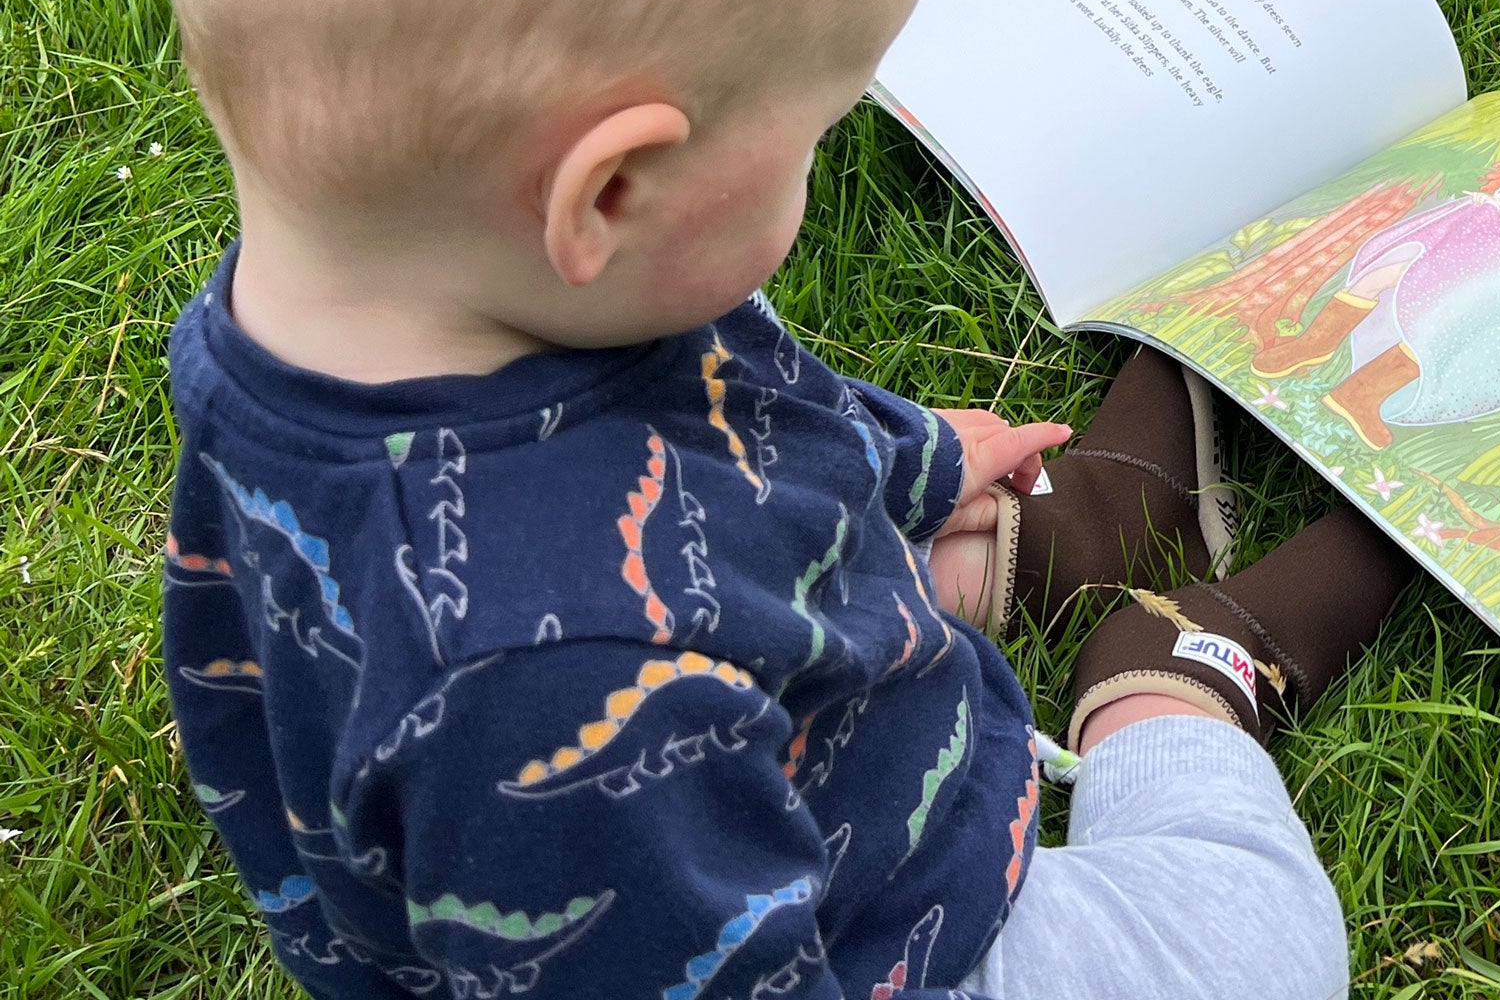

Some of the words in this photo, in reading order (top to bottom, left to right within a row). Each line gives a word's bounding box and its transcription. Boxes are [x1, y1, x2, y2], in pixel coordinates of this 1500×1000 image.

[1093, 17, 1121, 45] Luckily,
[1120, 43, 1134, 56] the
[1132, 57, 1154, 77] dress
[1100, 0, 1112, 7] at
[1108, 4, 1123, 18] her
[1120, 17, 1140, 35] Sitka
[1138, 34, 1169, 67] Slippers,
[1168, 66, 1183, 81] the
[1181, 80, 1204, 106] heavy
[1193, 8, 1210, 25] The
[1207, 25, 1230, 46] silver
[1228, 46, 1246, 63] will
[1216, 7, 1227, 16] to
[1224, 16, 1239, 29] the
[1237, 30, 1260, 56] dance.
[1260, 57, 1276, 75] But
[1262, 4, 1284, 24] dress
[1281, 25, 1302, 48] sewn
[1151, 20, 1163, 31] up
[1161, 30, 1171, 39] to
[1169, 38, 1193, 62] thank
[1189, 61, 1204, 76] the
[1202, 77, 1222, 103] eagle,
